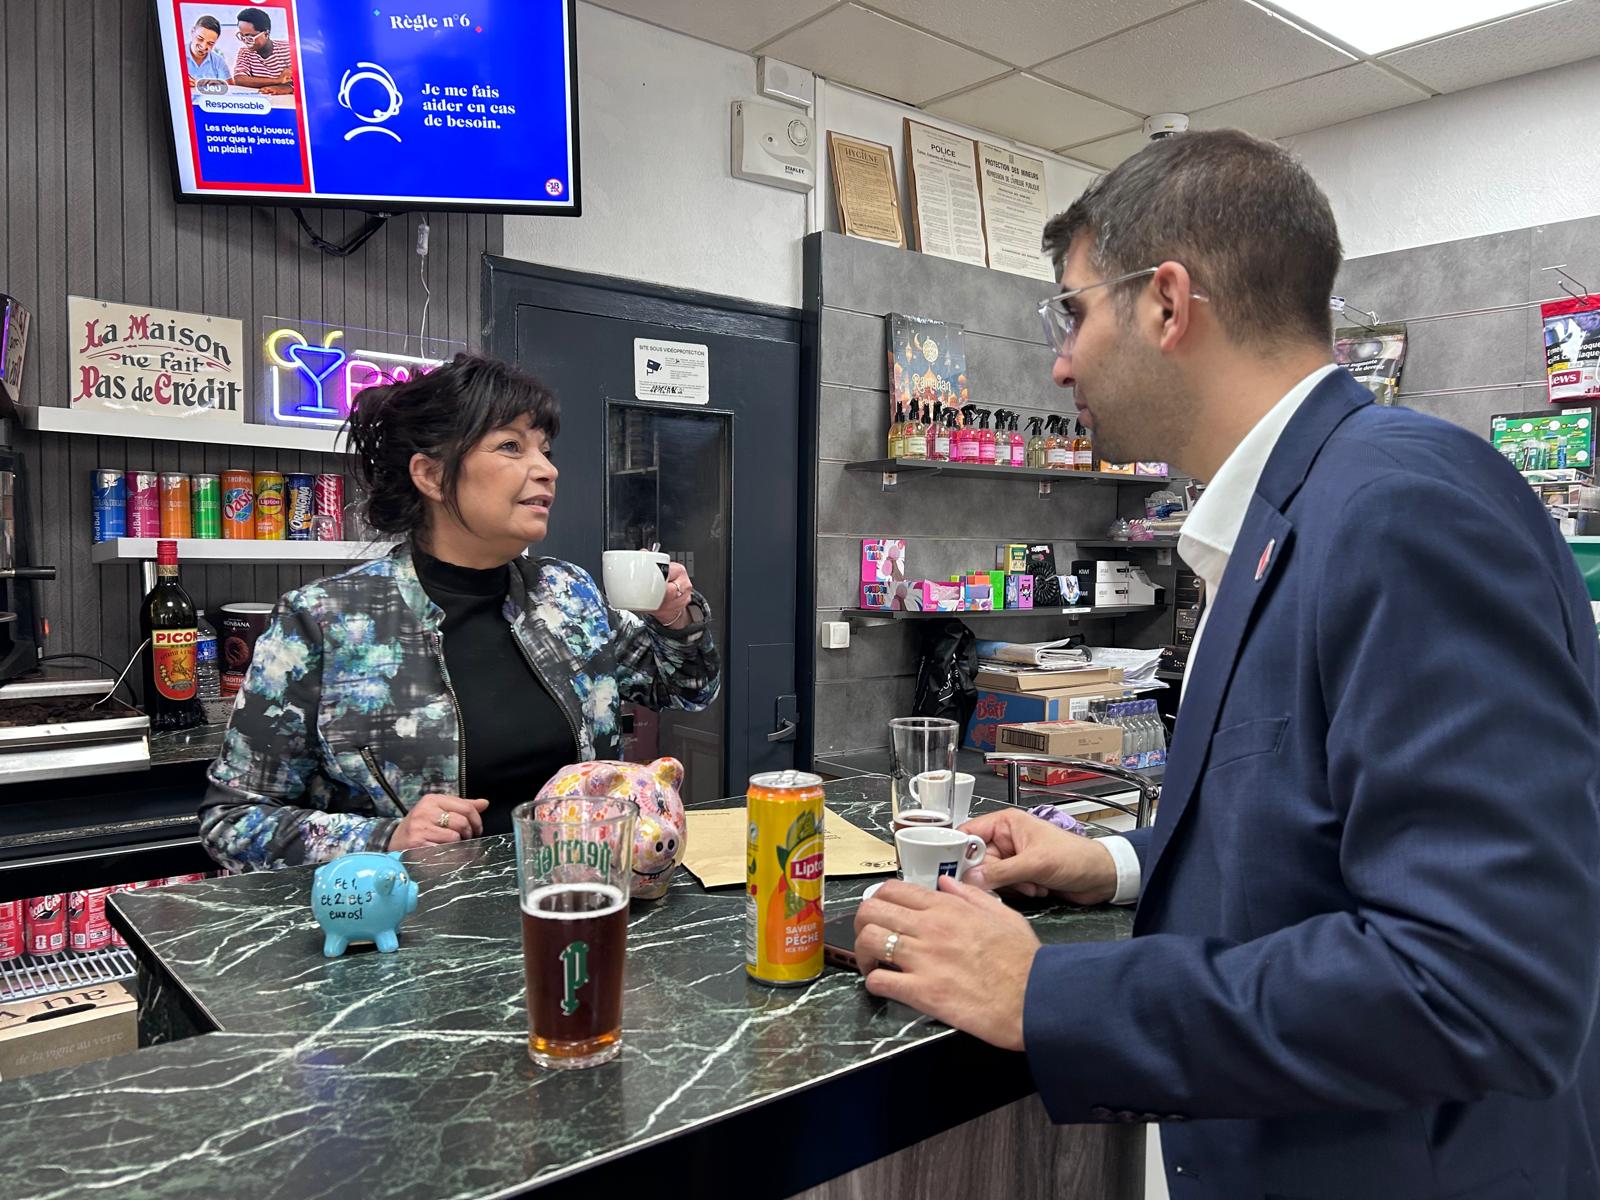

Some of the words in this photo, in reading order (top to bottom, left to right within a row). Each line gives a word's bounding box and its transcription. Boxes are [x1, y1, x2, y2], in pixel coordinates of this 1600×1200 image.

[390, 14, 438, 32] Règle
[443, 13, 471, 28] n°6
[203, 83, 221, 92] Jeu
[421, 83, 441, 96] Je
[444, 85, 468, 97] me
[472, 85, 500, 98] fais
[205, 100, 265, 111] Responsable
[422, 99, 463, 112] aider
[467, 101, 486, 113] en
[490, 103, 516, 115] cas
[205, 123, 220, 132] Les
[221, 124, 249, 134] règles
[250, 124, 262, 134] du
[263, 125, 294, 136] joueur,
[424, 115, 443, 127] de
[447, 115, 501, 129] besoin.
[206, 134, 227, 144] pour
[229, 135, 246, 144] que
[247, 135, 255, 144] le
[256, 136, 271, 145] jeu
[272, 137, 295, 145] reste
[208, 145, 219, 153] un
[221, 145, 248, 155] plaisir
[930, 143, 956, 158] POLICE
[784, 165, 805, 174] STANLEY
[985, 157, 1010, 172] PROTECTION
[80, 319, 118, 354] La
[123, 313, 232, 366] Maison
[122, 353, 151, 369] ne
[1552, 374, 1577, 385] ews
[73, 365, 127, 403] Pas
[132, 376, 153, 403] de
[154, 372, 242, 411] Crédit
[224, 487, 254, 520] Oasis
[289, 486, 310, 529] ORANGINA
[795, 860, 823, 878] Lipto
[335, 878, 347, 890] Et
[321, 896, 332, 906] et
[348, 894, 364, 905] et
[366, 891, 373, 902] 3
[329, 907, 362, 920] euros!
[785, 922, 817, 934] SAVEUR
